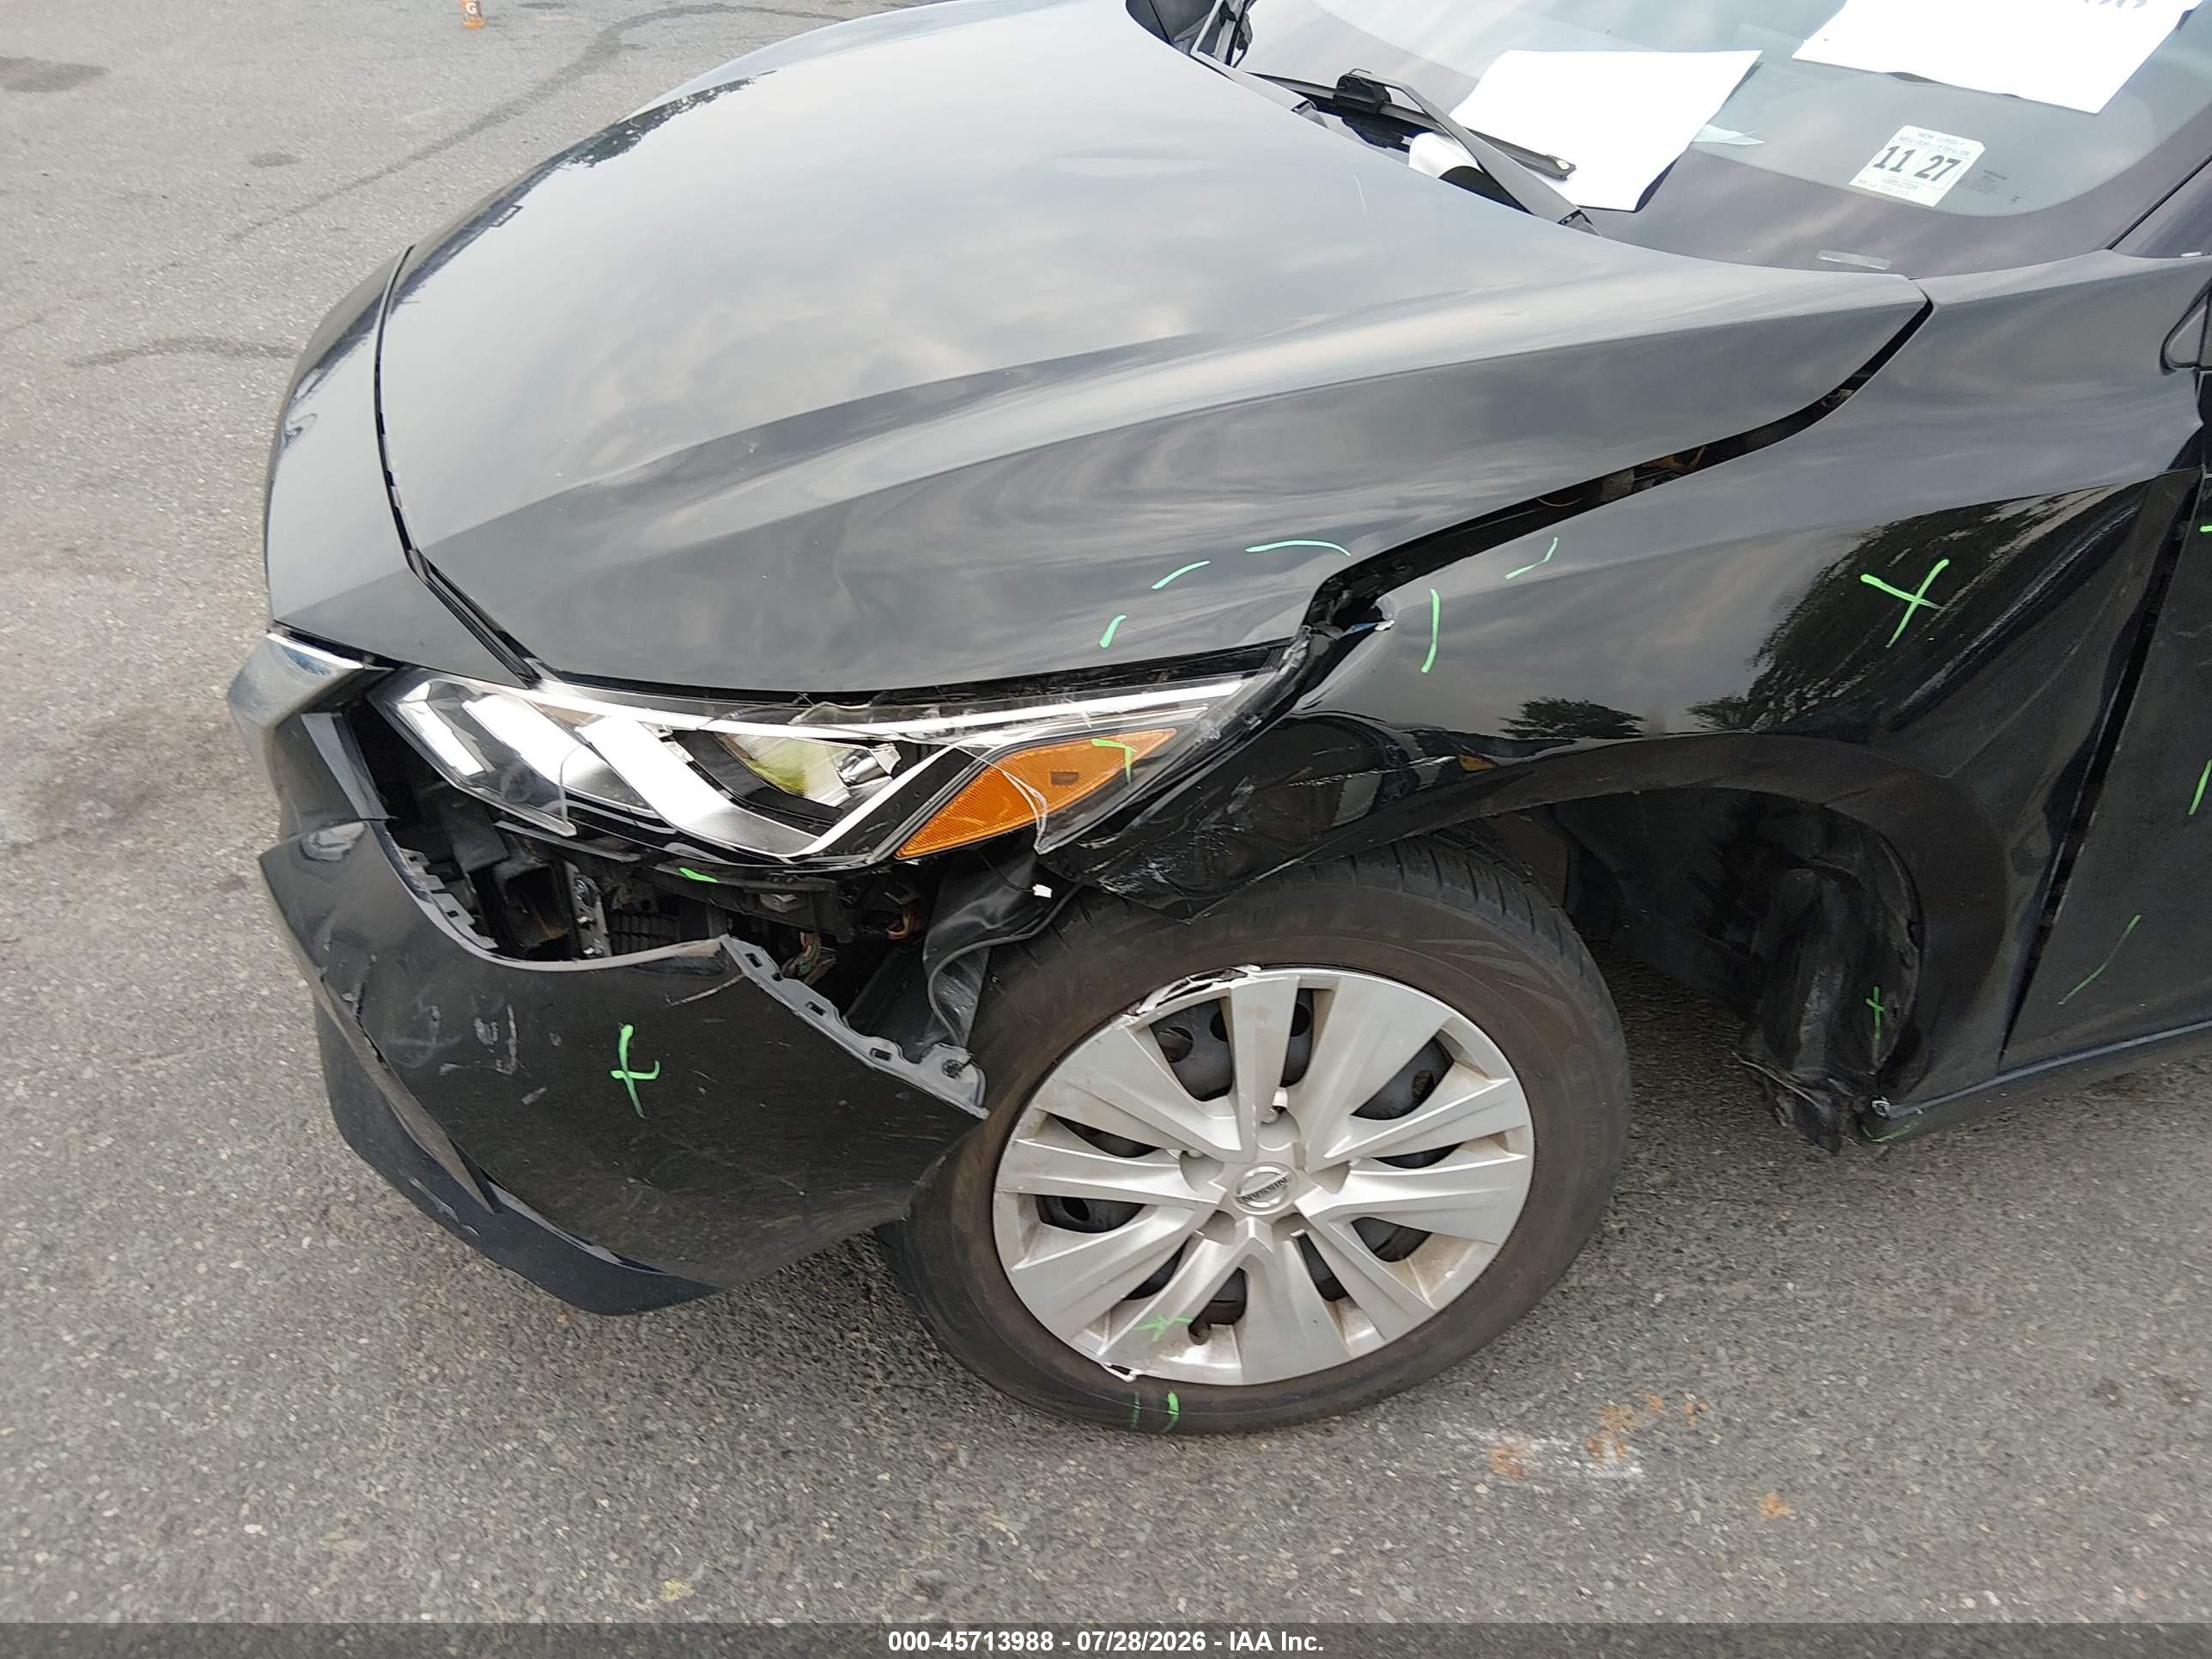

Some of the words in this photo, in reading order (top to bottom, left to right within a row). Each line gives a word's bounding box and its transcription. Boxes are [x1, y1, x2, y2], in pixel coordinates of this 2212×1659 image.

[1873, 145, 1916, 173] 11
[1914, 155, 1960, 181] 27
[1242, 1177, 1288, 1202] NISSAN
